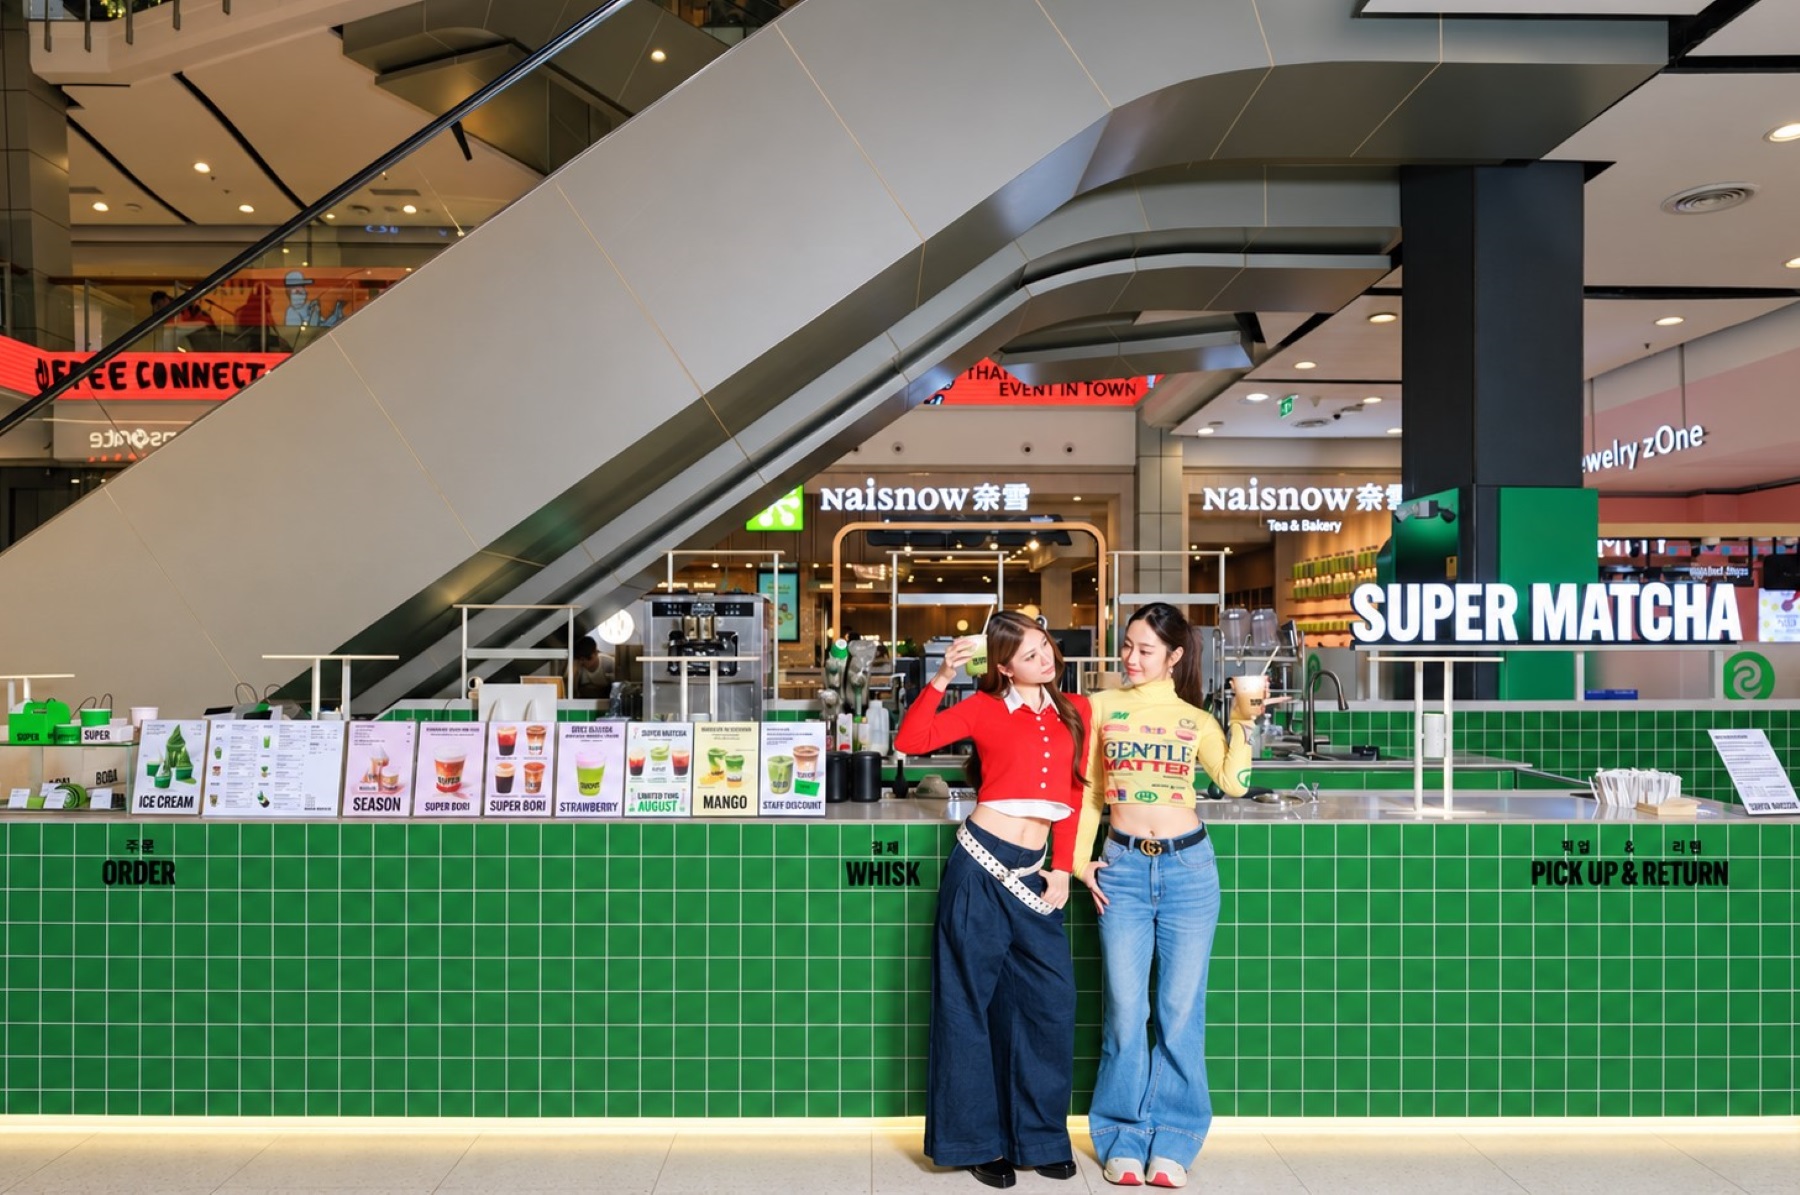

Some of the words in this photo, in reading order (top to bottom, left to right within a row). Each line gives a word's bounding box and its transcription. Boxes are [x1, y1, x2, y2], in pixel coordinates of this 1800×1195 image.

[136, 362, 265, 389] CONNECT
[1060, 382, 1077, 396] IN
[1084, 381, 1136, 396] TOWN
[820, 477, 969, 511] Naisnow
[972, 482, 1030, 511] 奈雪
[1203, 477, 1354, 511] Naisnow
[1267, 519, 1289, 532] Tea
[1290, 520, 1300, 531] &
[1301, 519, 1342, 534] Bakery
[1351, 583, 1518, 642] SUPER
[1532, 583, 1743, 642] MATCHA
[84, 729, 111, 741] SUPER
[1103, 741, 1193, 763] GENTLE
[1104, 759, 1190, 777] MATTER
[138, 795, 155, 809] ICE
[157, 795, 195, 809] CREAM
[352, 796, 402, 812] SEASON
[424, 802, 450, 812] SUPER
[489, 800, 521, 812] SUPER
[522, 800, 546, 811] BORI
[560, 801, 619, 812] STRAWBERRY
[637, 800, 678, 813] AUGUST
[703, 794, 748, 810] MANGO
[762, 801, 785, 810] STAFF
[785, 801, 822, 810] DISCOUNT
[1624, 841, 1635, 853] &
[102, 860, 176, 886] ORDER
[846, 861, 921, 887] WHISK
[1532, 860, 1583, 886] PICK
[1588, 860, 1618, 886] UP
[1621, 860, 1638, 886] &
[1643, 860, 1729, 886] RETURN
